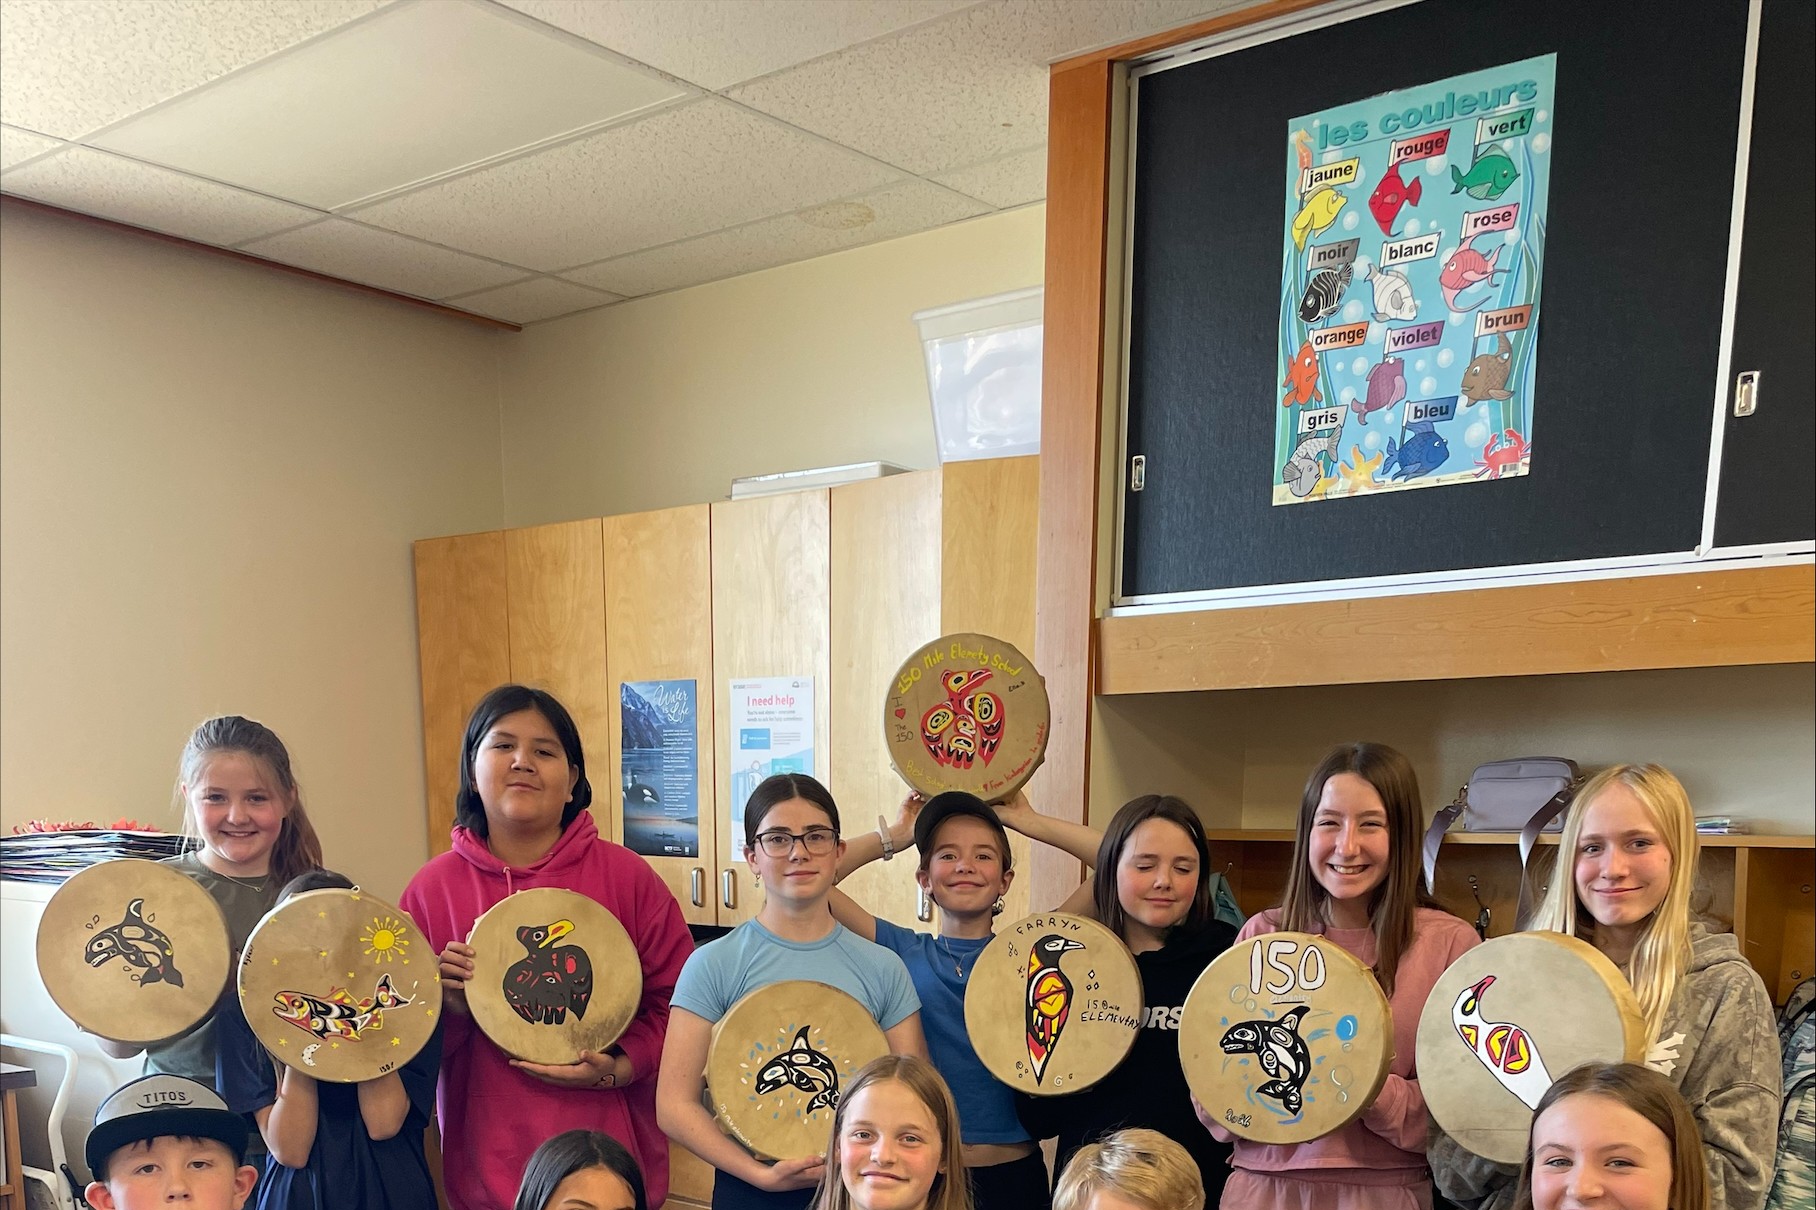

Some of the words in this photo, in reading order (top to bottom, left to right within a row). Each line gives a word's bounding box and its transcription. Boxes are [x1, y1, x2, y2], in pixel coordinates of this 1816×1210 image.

[1318, 122, 1369, 149] les
[1379, 78, 1538, 135] couleurs
[1489, 115, 1527, 136] vert
[1396, 136, 1445, 159] rouge
[1307, 164, 1354, 190] jaune
[1472, 209, 1512, 229] rose
[1317, 244, 1350, 262] noir
[1388, 240, 1435, 260] blanc
[1484, 310, 1525, 329] brun
[1314, 326, 1365, 347] orange
[1391, 326, 1439, 347] violet
[1307, 411, 1339, 430] gris
[1413, 402, 1450, 419] bleu
[897, 667, 922, 694] 150
[654, 685, 688, 706] Water
[752, 694, 773, 706] need
[775, 694, 795, 707] help
[668, 701, 689, 723] Life
[896, 730, 914, 742] 150
[1016, 917, 1081, 935] FARRYN
[1250, 939, 1326, 995] 150
